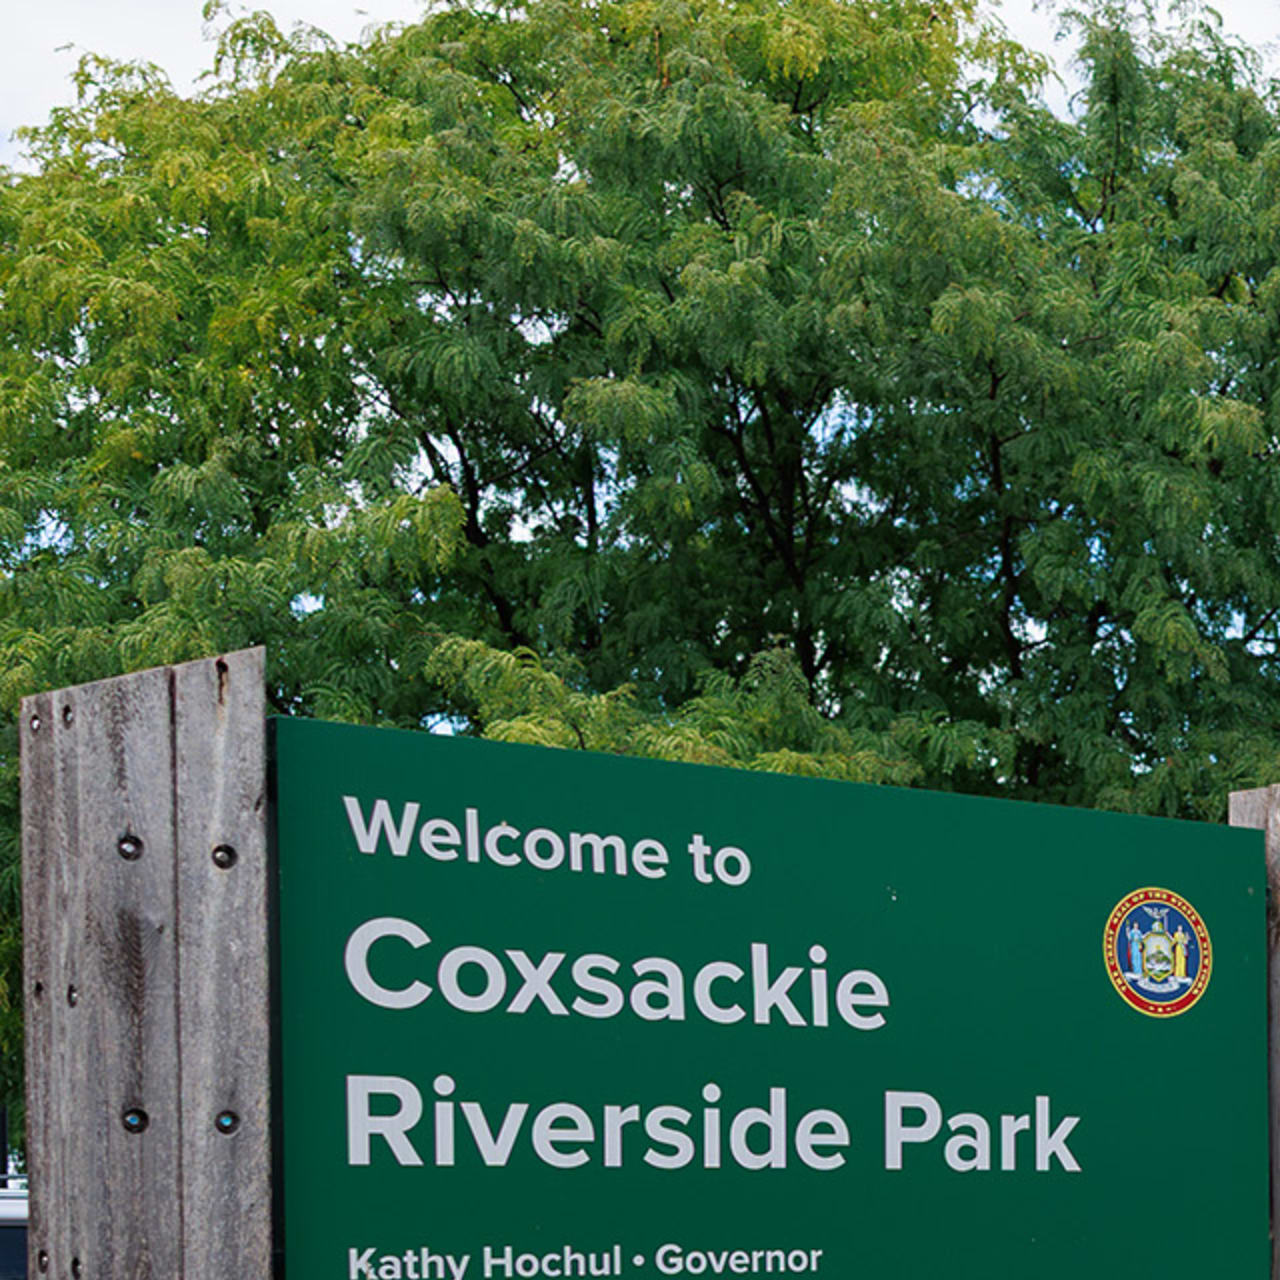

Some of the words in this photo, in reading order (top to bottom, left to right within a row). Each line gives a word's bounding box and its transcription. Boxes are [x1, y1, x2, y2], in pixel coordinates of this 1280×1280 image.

[343, 795, 669, 879] Welcome
[687, 832, 752, 887] to
[344, 916, 890, 1030] Coxsackie
[346, 1074, 850, 1171] Riverside
[885, 1090, 1082, 1172] Park
[483, 1244, 621, 1278] Hochul
[655, 1243, 823, 1275] Governor
